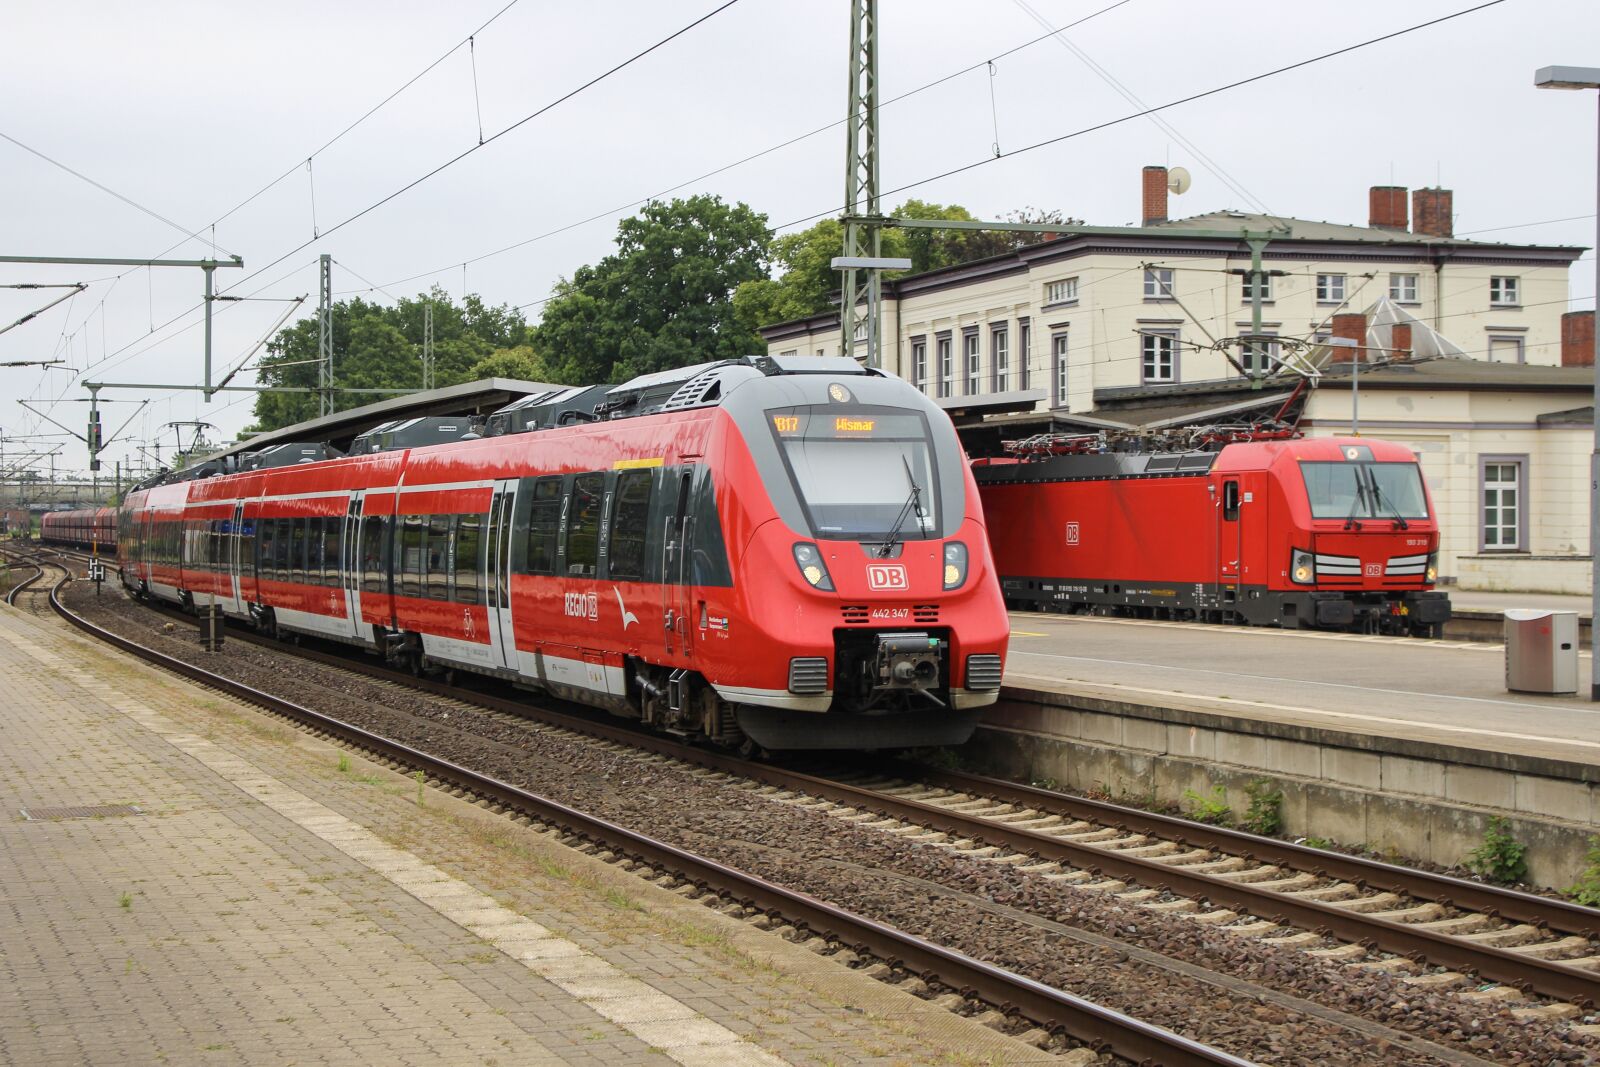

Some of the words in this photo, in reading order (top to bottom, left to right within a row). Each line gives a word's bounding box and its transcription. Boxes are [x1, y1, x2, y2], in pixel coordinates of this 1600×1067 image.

[835, 417, 875, 431] Wismar
[1067, 524, 1078, 543] DB
[93, 566, 104, 580] H
[870, 566, 906, 588] DB
[1366, 564, 1381, 576] DB
[564, 592, 587, 618] REGIO
[588, 594, 598, 619] DB
[872, 608, 890, 618] 442
[891, 608, 909, 618] 347
